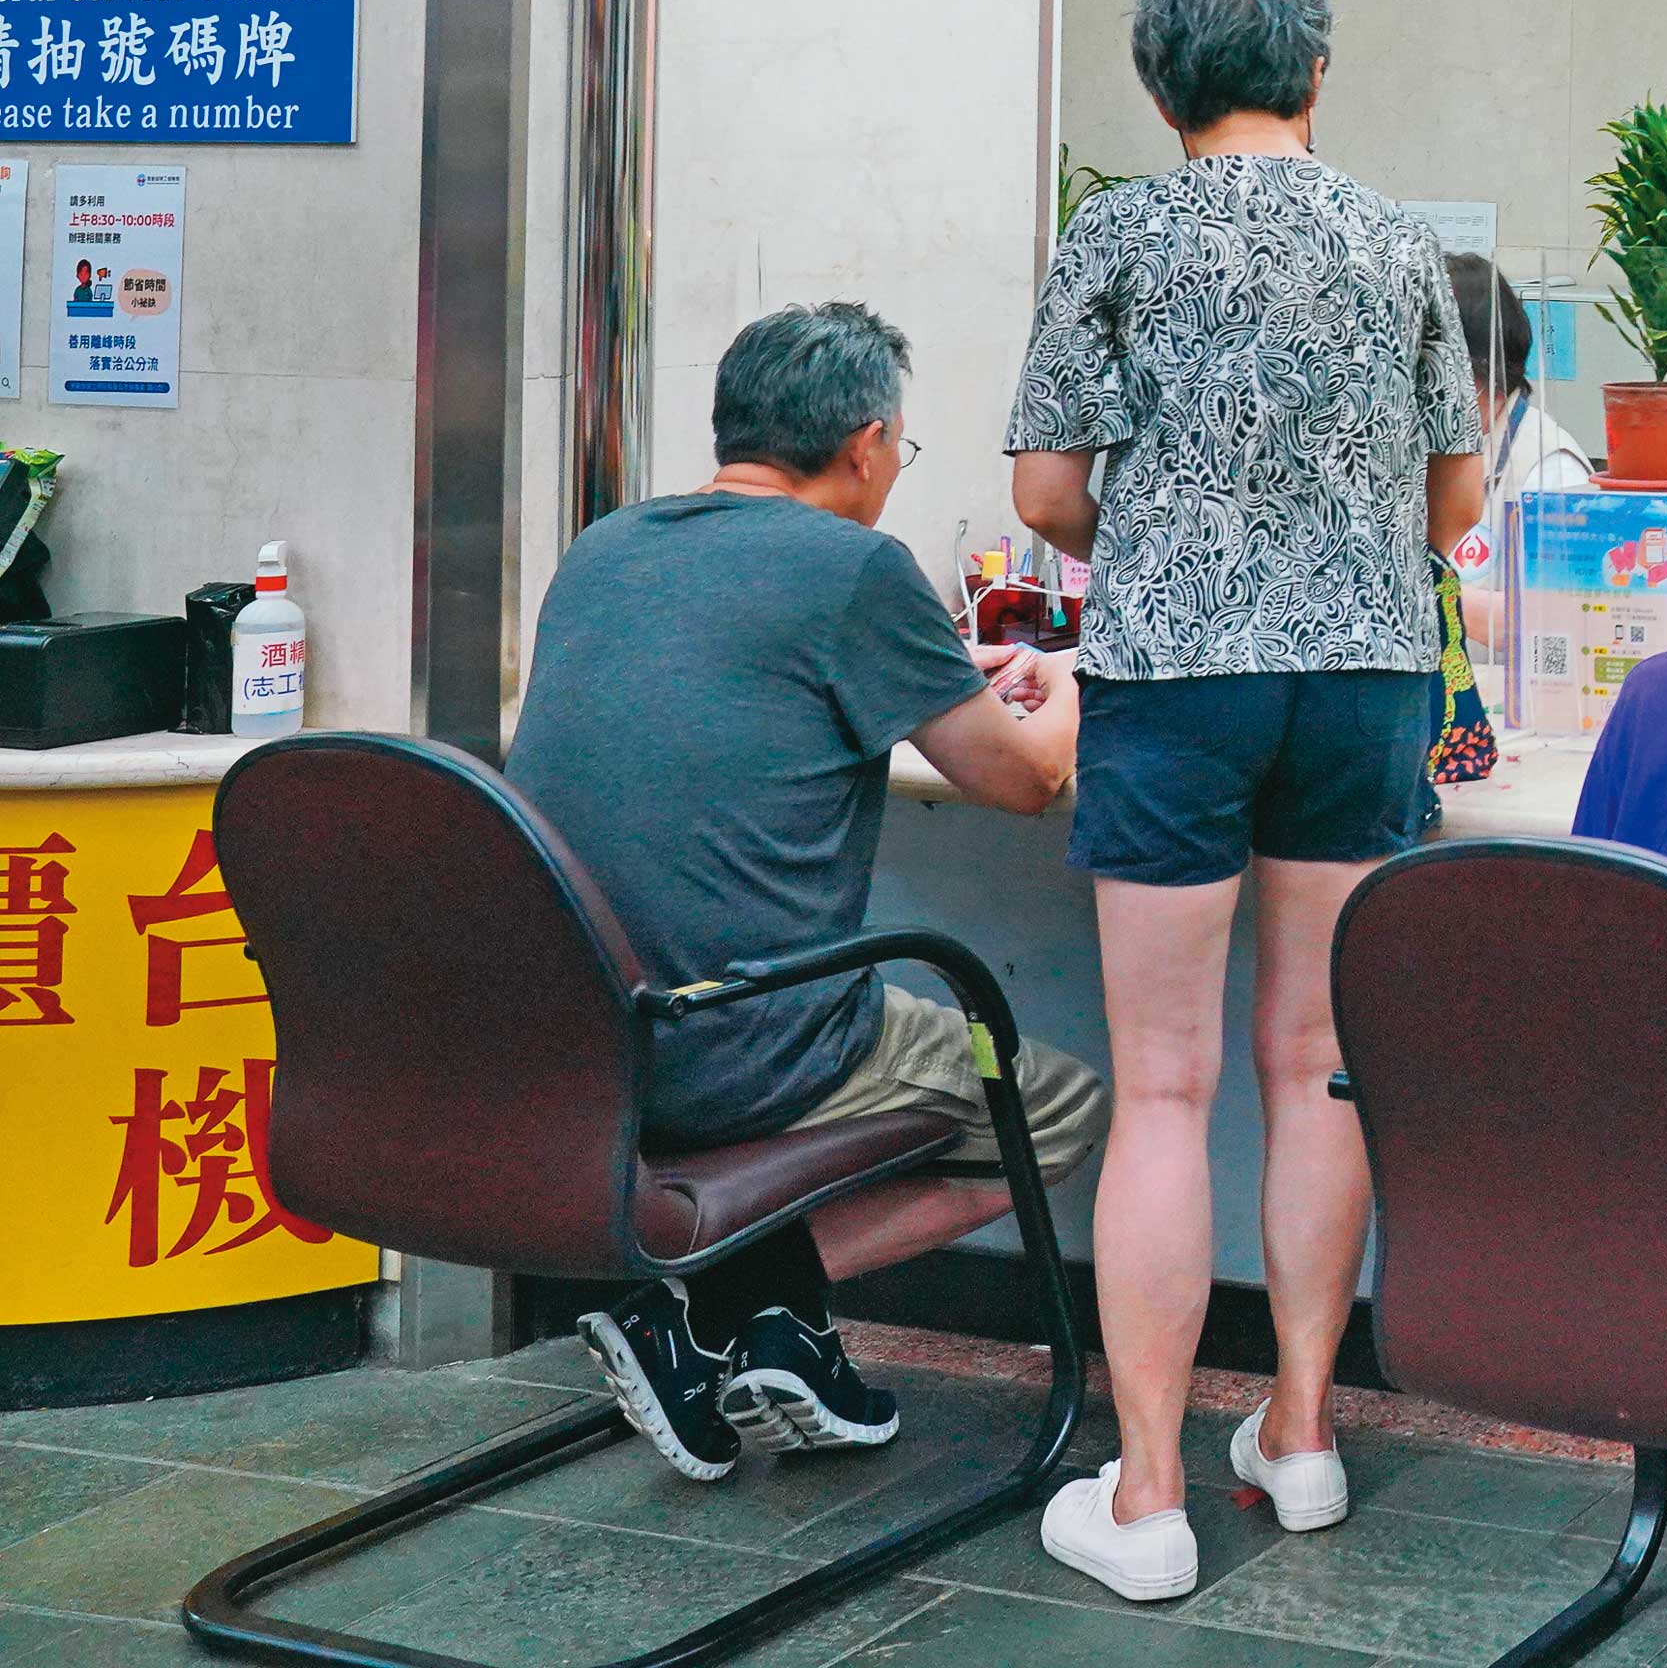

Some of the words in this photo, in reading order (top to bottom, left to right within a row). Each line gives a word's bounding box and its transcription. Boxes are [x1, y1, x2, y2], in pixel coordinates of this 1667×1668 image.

[63, 96, 131, 129] take
[141, 107, 158, 128] a
[170, 95, 299, 129] number
[70, 196, 105, 207] 請多利用
[124, 278, 166, 292] 節省時間
[69, 335, 136, 349] 善用離峰時段
[90, 356, 159, 371] 落實洽公分流
